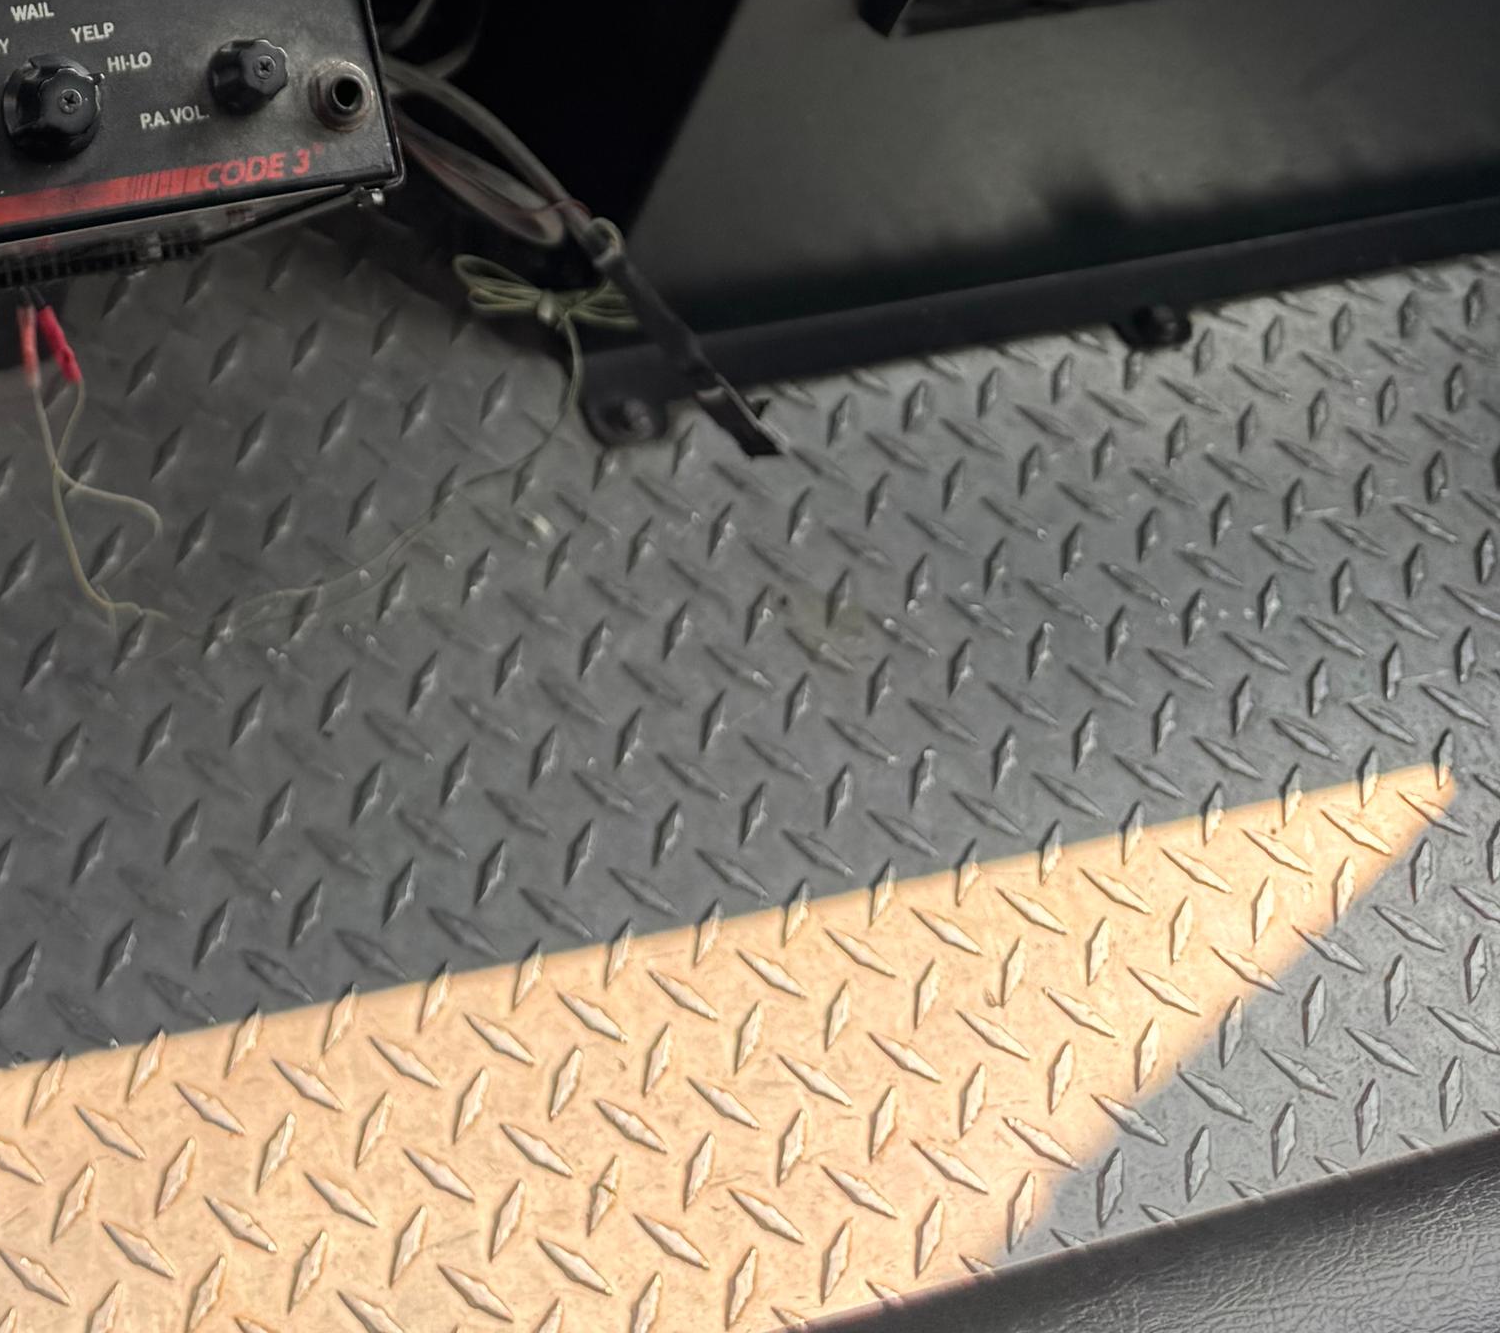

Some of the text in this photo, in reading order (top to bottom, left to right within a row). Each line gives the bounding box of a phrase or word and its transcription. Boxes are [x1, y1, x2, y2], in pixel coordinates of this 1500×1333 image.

[10, 2, 55, 22] WAIL
[70, 22, 115, 44] YELP
[107, 51, 153, 73] HI-LO
[204, 148, 310, 190] CODE 3
